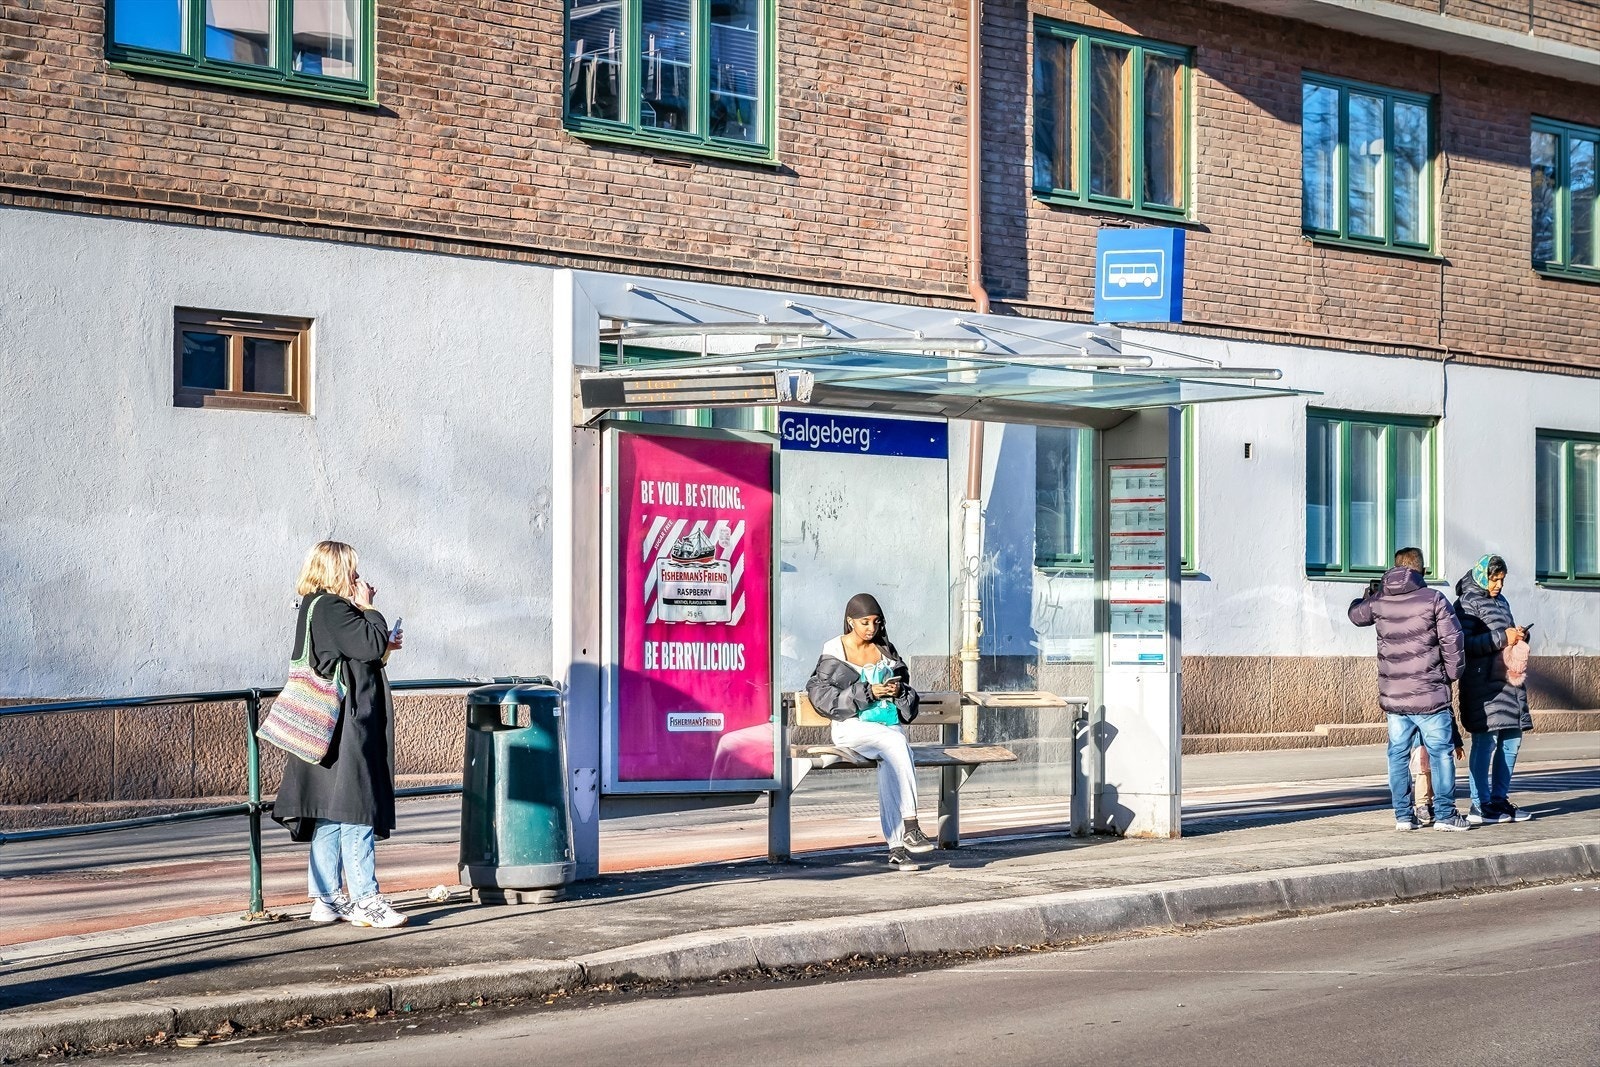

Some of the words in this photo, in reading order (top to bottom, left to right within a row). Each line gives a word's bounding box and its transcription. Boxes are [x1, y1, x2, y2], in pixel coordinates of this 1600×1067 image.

[782, 418, 870, 451] Galgeberg
[641, 480, 655, 504] BE
[657, 481, 683, 506] YOU.
[685, 483, 698, 507] BE
[700, 484, 745, 510] STRONG.
[654, 531, 666, 551] SUGAR
[663, 519, 674, 533] FREE
[677, 588, 712, 596] RASPBERRY
[644, 641, 659, 670] BE
[661, 641, 745, 671] BERRYLICIOUS
